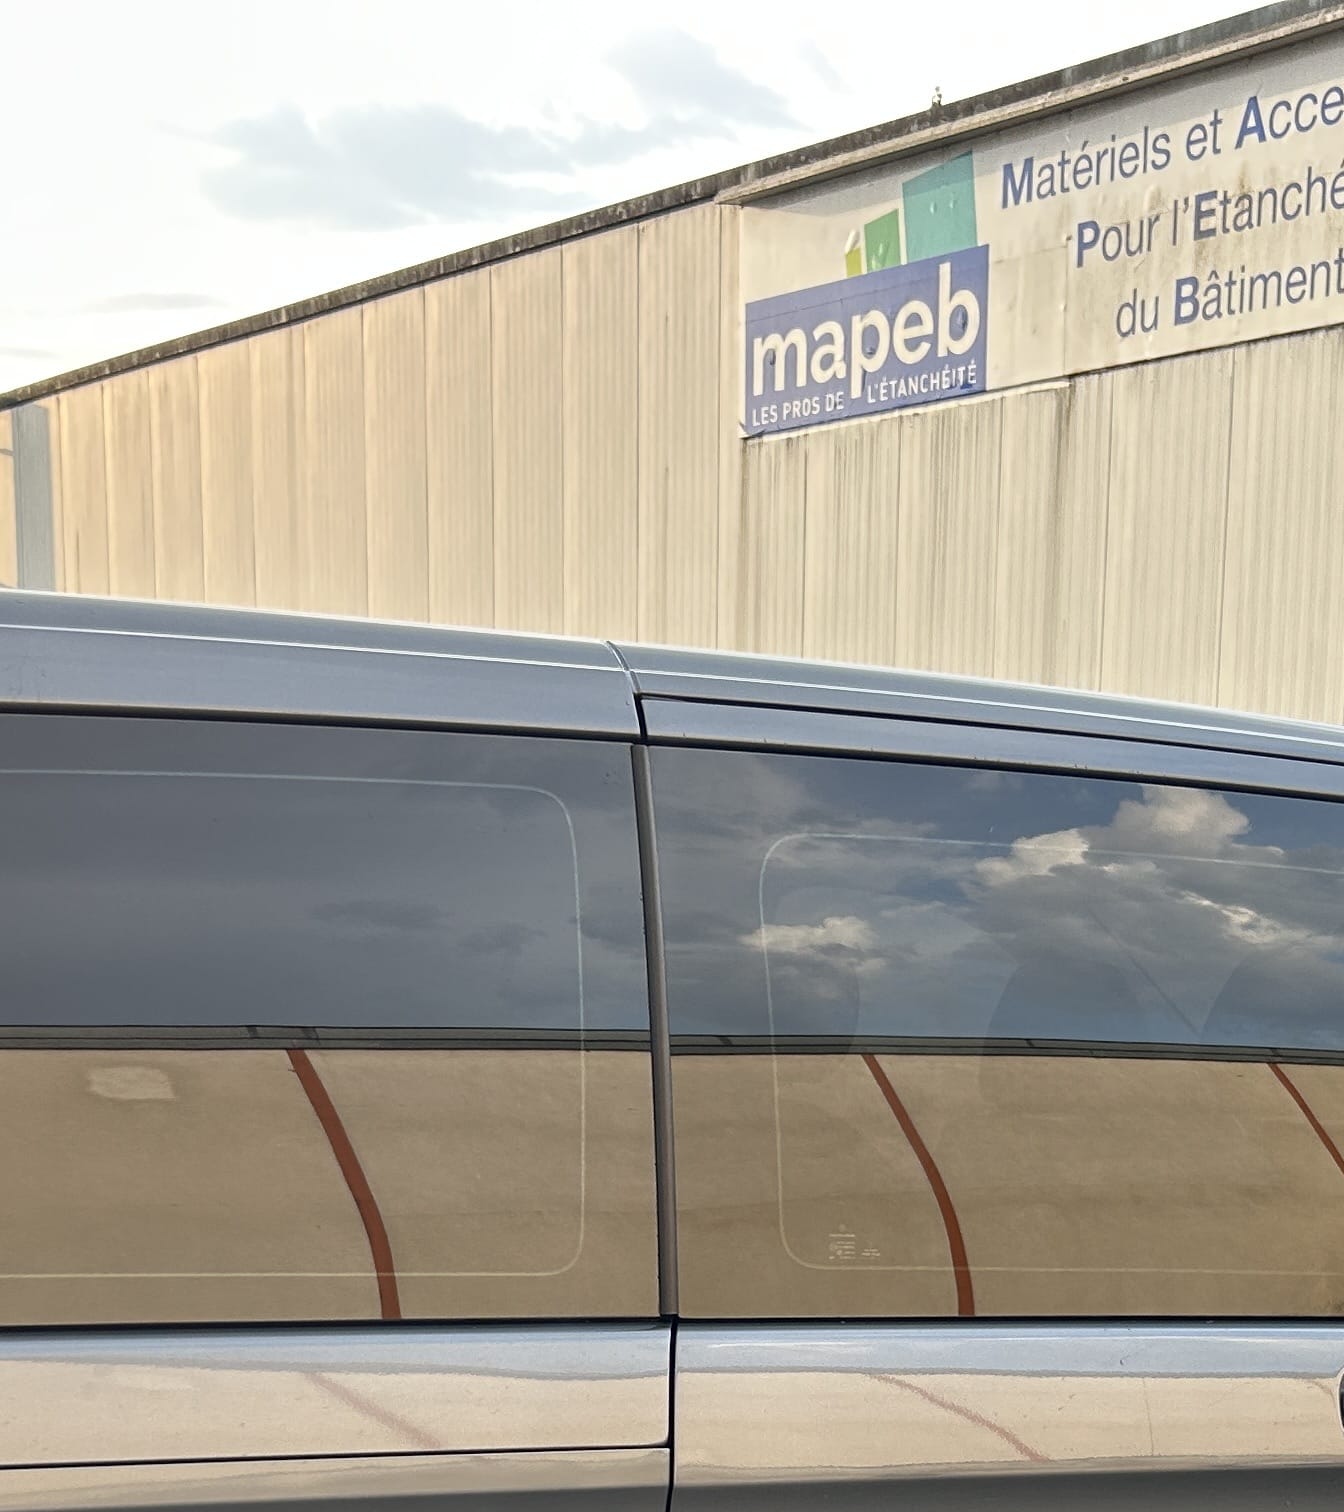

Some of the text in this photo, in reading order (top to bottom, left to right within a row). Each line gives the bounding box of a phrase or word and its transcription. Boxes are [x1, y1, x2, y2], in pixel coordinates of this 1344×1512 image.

[1001, 125, 1172, 209] Matériels
[1185, 108, 1223, 162] et
[1076, 214, 1161, 269] Pour
[752, 261, 981, 400] mapeb
[1115, 287, 1160, 338] du
[751, 359, 978, 427] LES PROS DE L'ÉTANCHÉITÉ
